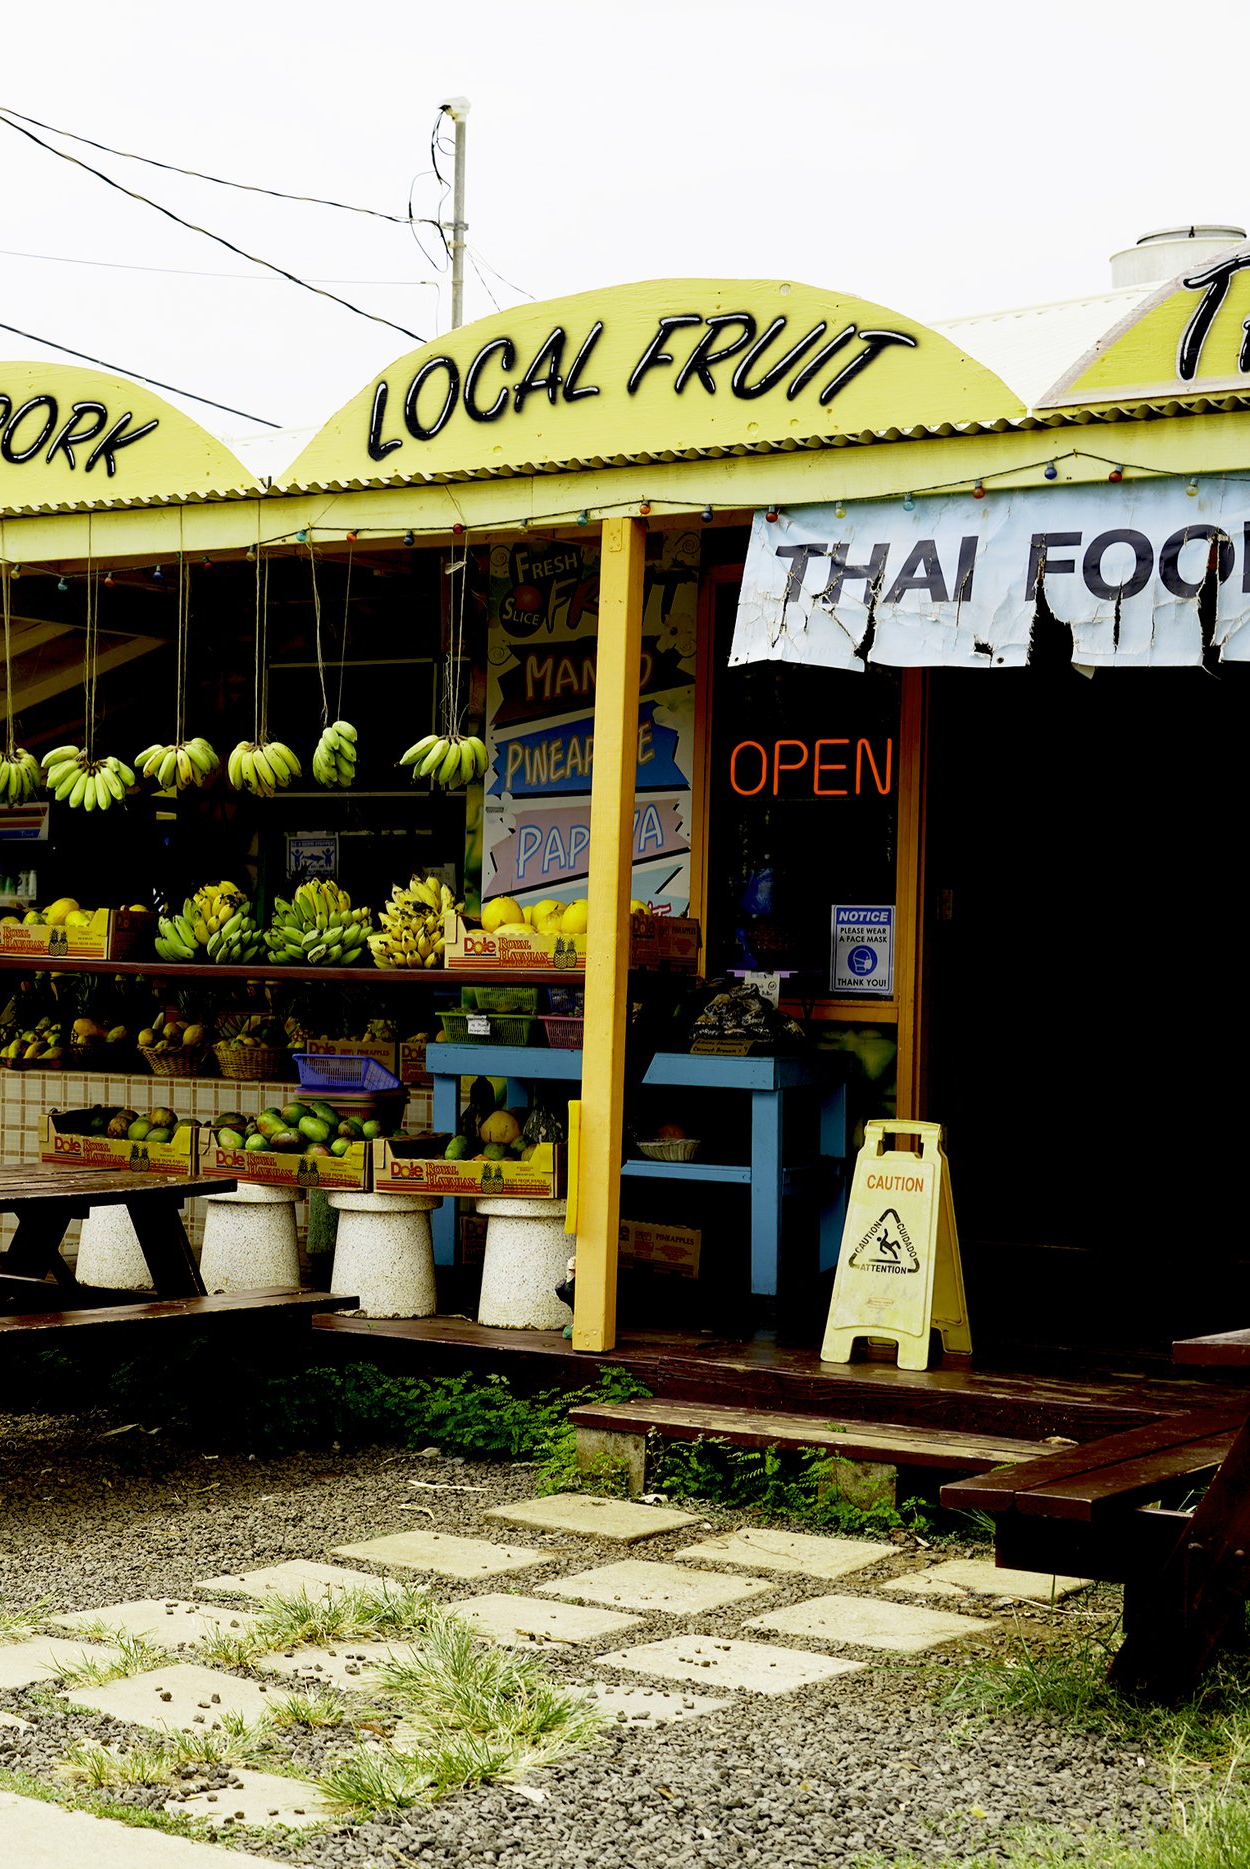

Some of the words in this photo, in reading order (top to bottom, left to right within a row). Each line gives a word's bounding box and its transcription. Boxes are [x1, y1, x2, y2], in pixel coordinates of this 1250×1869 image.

[367, 320, 604, 462] LOCAL
[627, 311, 917, 406] FRUIT
[515, 551, 579, 583] FRESH
[775, 535, 979, 603] THAI
[1025, 521, 1250, 603] FOO
[503, 597, 540, 626] SLICE
[730, 738, 893, 796] OPEN
[839, 911, 889, 922] NOTICE
[464, 937, 496, 955] Dole
[498, 938, 532, 950] ROYAL
[866, 979, 887, 987] YOU!
[54, 1136, 81, 1152] Dole
[216, 1150, 245, 1167] Dole
[391, 1161, 424, 1177] Dole
[426, 1162, 460, 1175] ROYAL
[867, 1174, 924, 1192] CAUTION
[854, 1220, 882, 1254] CAUTION
[897, 1223, 917, 1258] CUIDADO
[860, 1263, 907, 1275] ATTENTION
